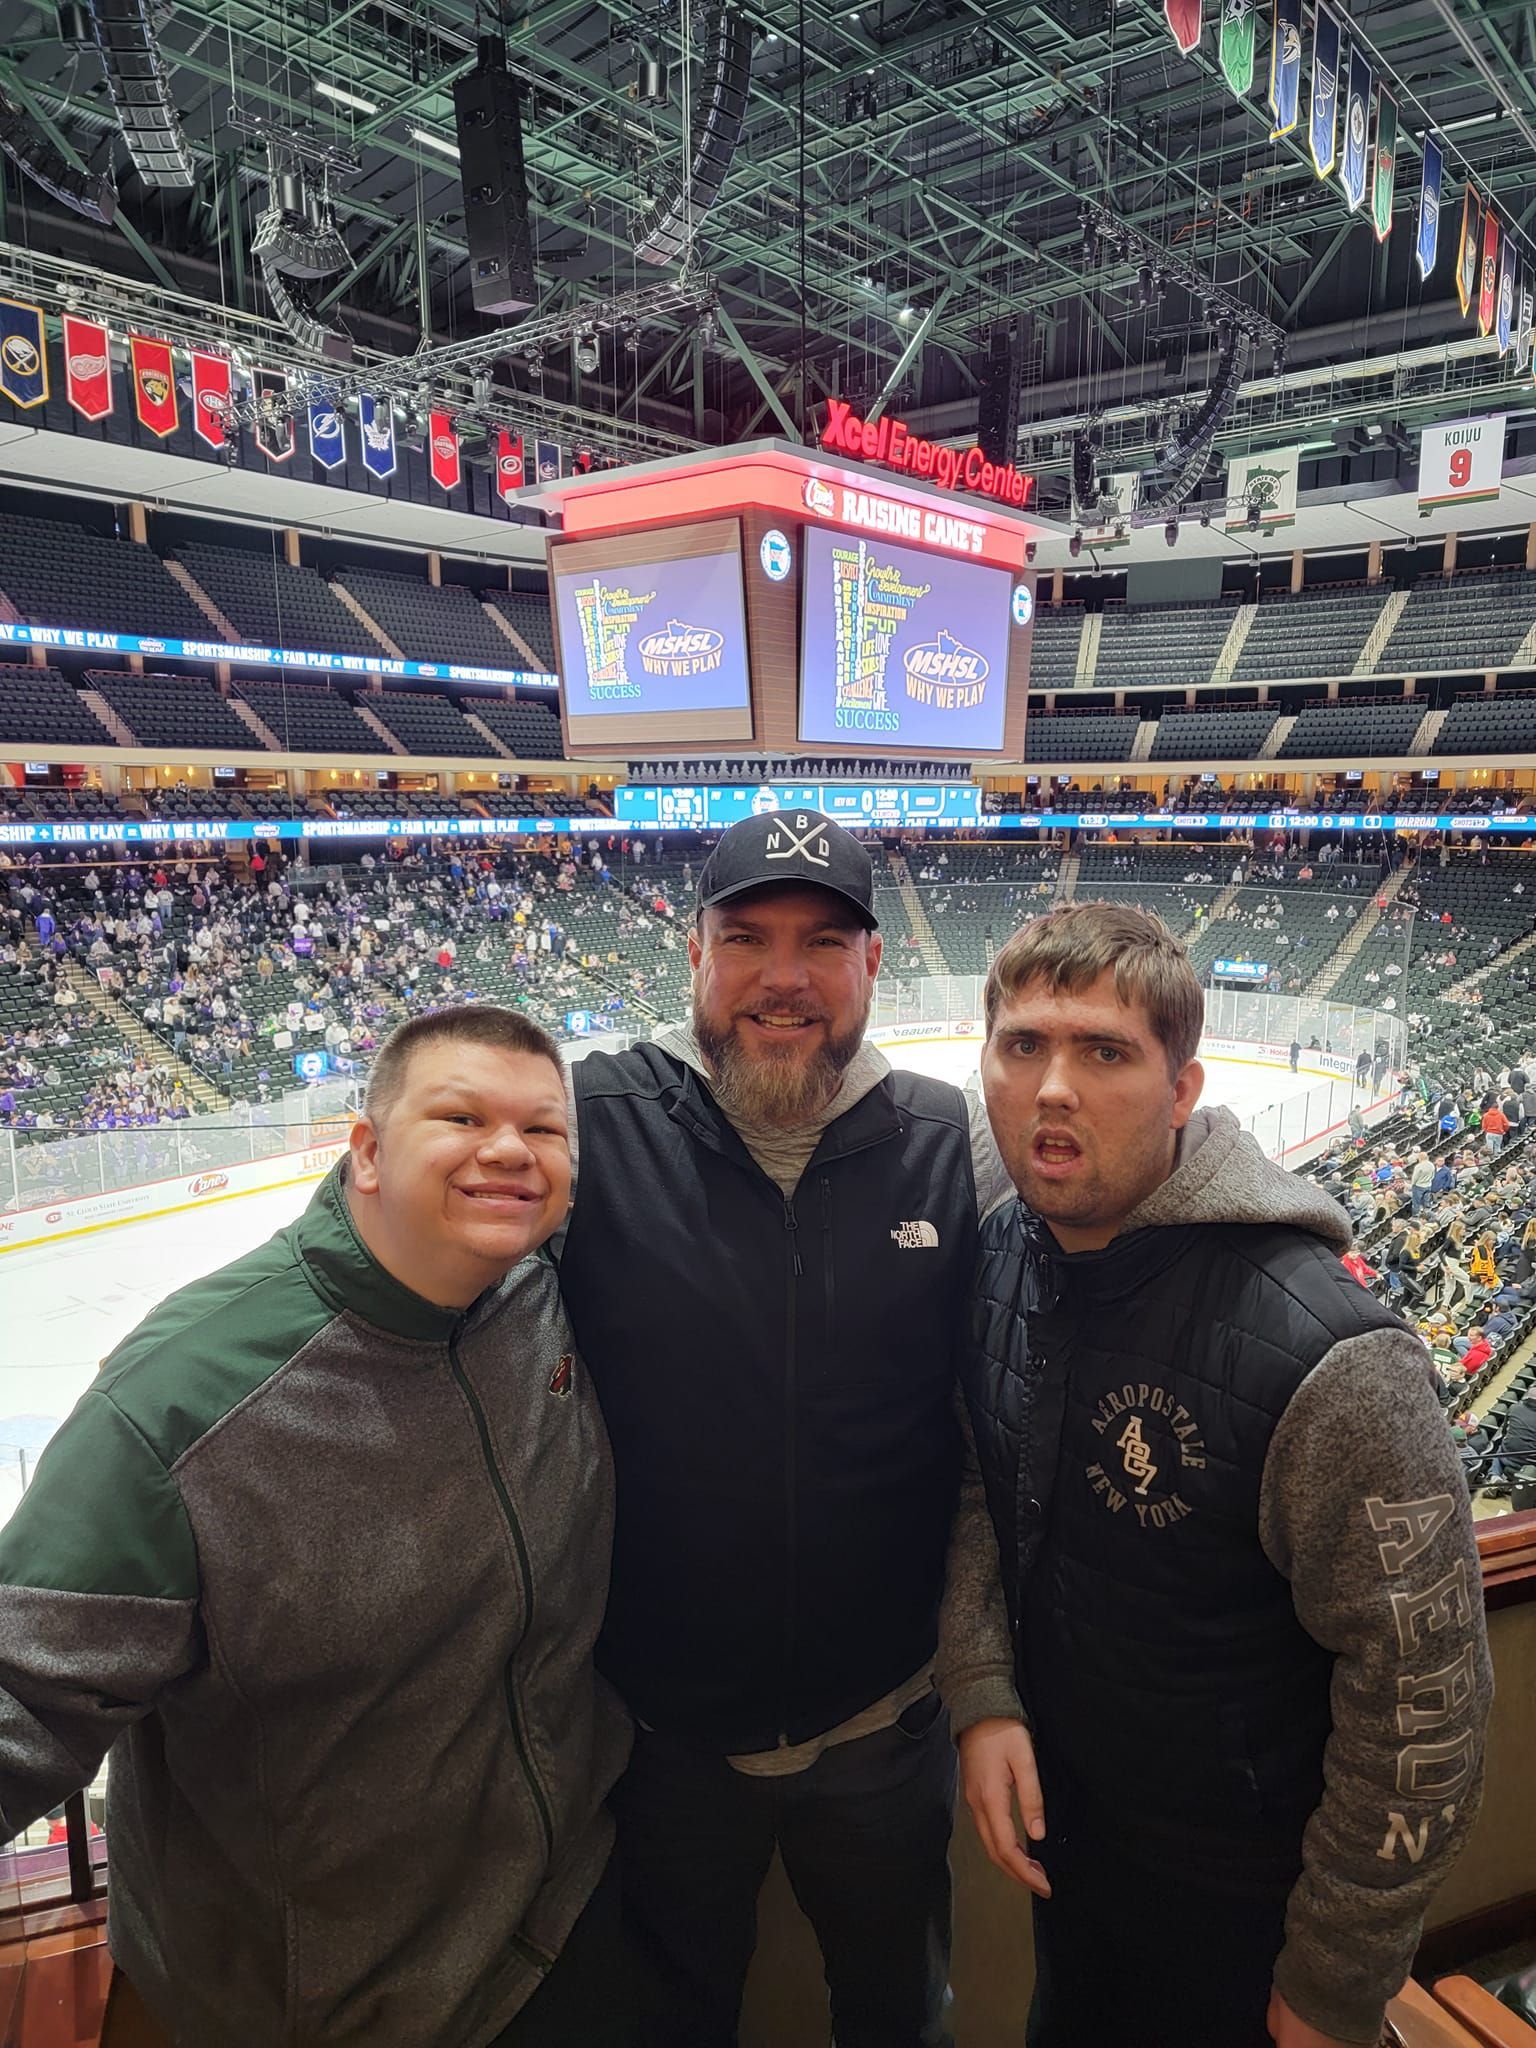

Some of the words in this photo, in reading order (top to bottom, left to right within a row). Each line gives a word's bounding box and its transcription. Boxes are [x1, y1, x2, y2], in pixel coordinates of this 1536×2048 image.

[1445, 427, 1481, 446] KOIVU
[822, 399, 888, 459] Xcel
[888, 420, 963, 490] Energy
[965, 447, 1033, 503] Center
[1449, 448, 1473, 488] 9
[842, 491, 920, 538] RAISING
[924, 513, 984, 553] CANE'S
[832, 548, 859, 563] COURAGE
[865, 557, 893, 584] Growth
[879, 580, 931, 598] Development
[864, 591, 907, 621] INSPIRATION
[30, 627, 60, 643] WHY
[63, 630, 84, 646] WE
[87, 633, 117, 649] PLAY
[644, 633, 712, 655] MSHSL
[182, 641, 271, 662] SPORTSMANSHIP
[282, 651, 306, 665] FAIR
[308, 653, 332, 668] PLAY
[341, 656, 364, 670] WHY
[366, 658, 380, 671] WE
[382, 660, 404, 673] PLAY
[642, 656, 670, 676] WHY
[671, 660, 690, 676] WE
[692, 650, 722, 674] PLAY
[907, 650, 979, 679] MSHSL
[449, 665, 514, 682] SPORTSMANSHIP
[522, 672, 541, 685] FAIR
[590, 684, 642, 700] SUCCESS
[906, 672, 933, 705] WHY
[936, 686, 955, 709] WE
[957, 682, 985, 709] PLAY
[835, 708, 900, 731] SUCCESS
[663, 795, 674, 814] 0
[692, 795, 702, 814] 1
[862, 790, 873, 812] 0
[901, 790, 909, 811] 1
[53, 825, 87, 840] FAIR
[89, 824, 124, 840] PLAY
[140, 824, 170, 839] WHY
[173, 823, 193, 838] WE
[196, 823, 227, 838] PLAY
[302, 821, 390, 836] SPORTSMANSHIP
[400, 821, 424, 834] FAIR
[425, 820, 449, 834] PLAY
[458, 820, 480, 833] WHY
[481, 820, 496, 832] WE
[497, 820, 519, 832] PLAY
[905, 818, 928, 827] PLAY
[938, 817, 959, 827] WHY
[961, 817, 976, 827] WE
[978, 816, 1001, 827] PLAY
[1289, 816, 1318, 827] 12:00
[1395, 817, 1438, 827] WARROAD
[766, 832, 780, 850] N
[796, 814, 808, 829] B
[818, 837, 830, 857] D
[891, 1228, 920, 1240] NORTH
[900, 1221, 919, 1231] THE
[899, 1239, 923, 1248] FACE
[1091, 1383, 1206, 1469] AEROPOSTALE
[1086, 1461, 1128, 1513] NEW
[1135, 1492, 1192, 1528] YORK
[1365, 1494, 1476, 1800] AERO
